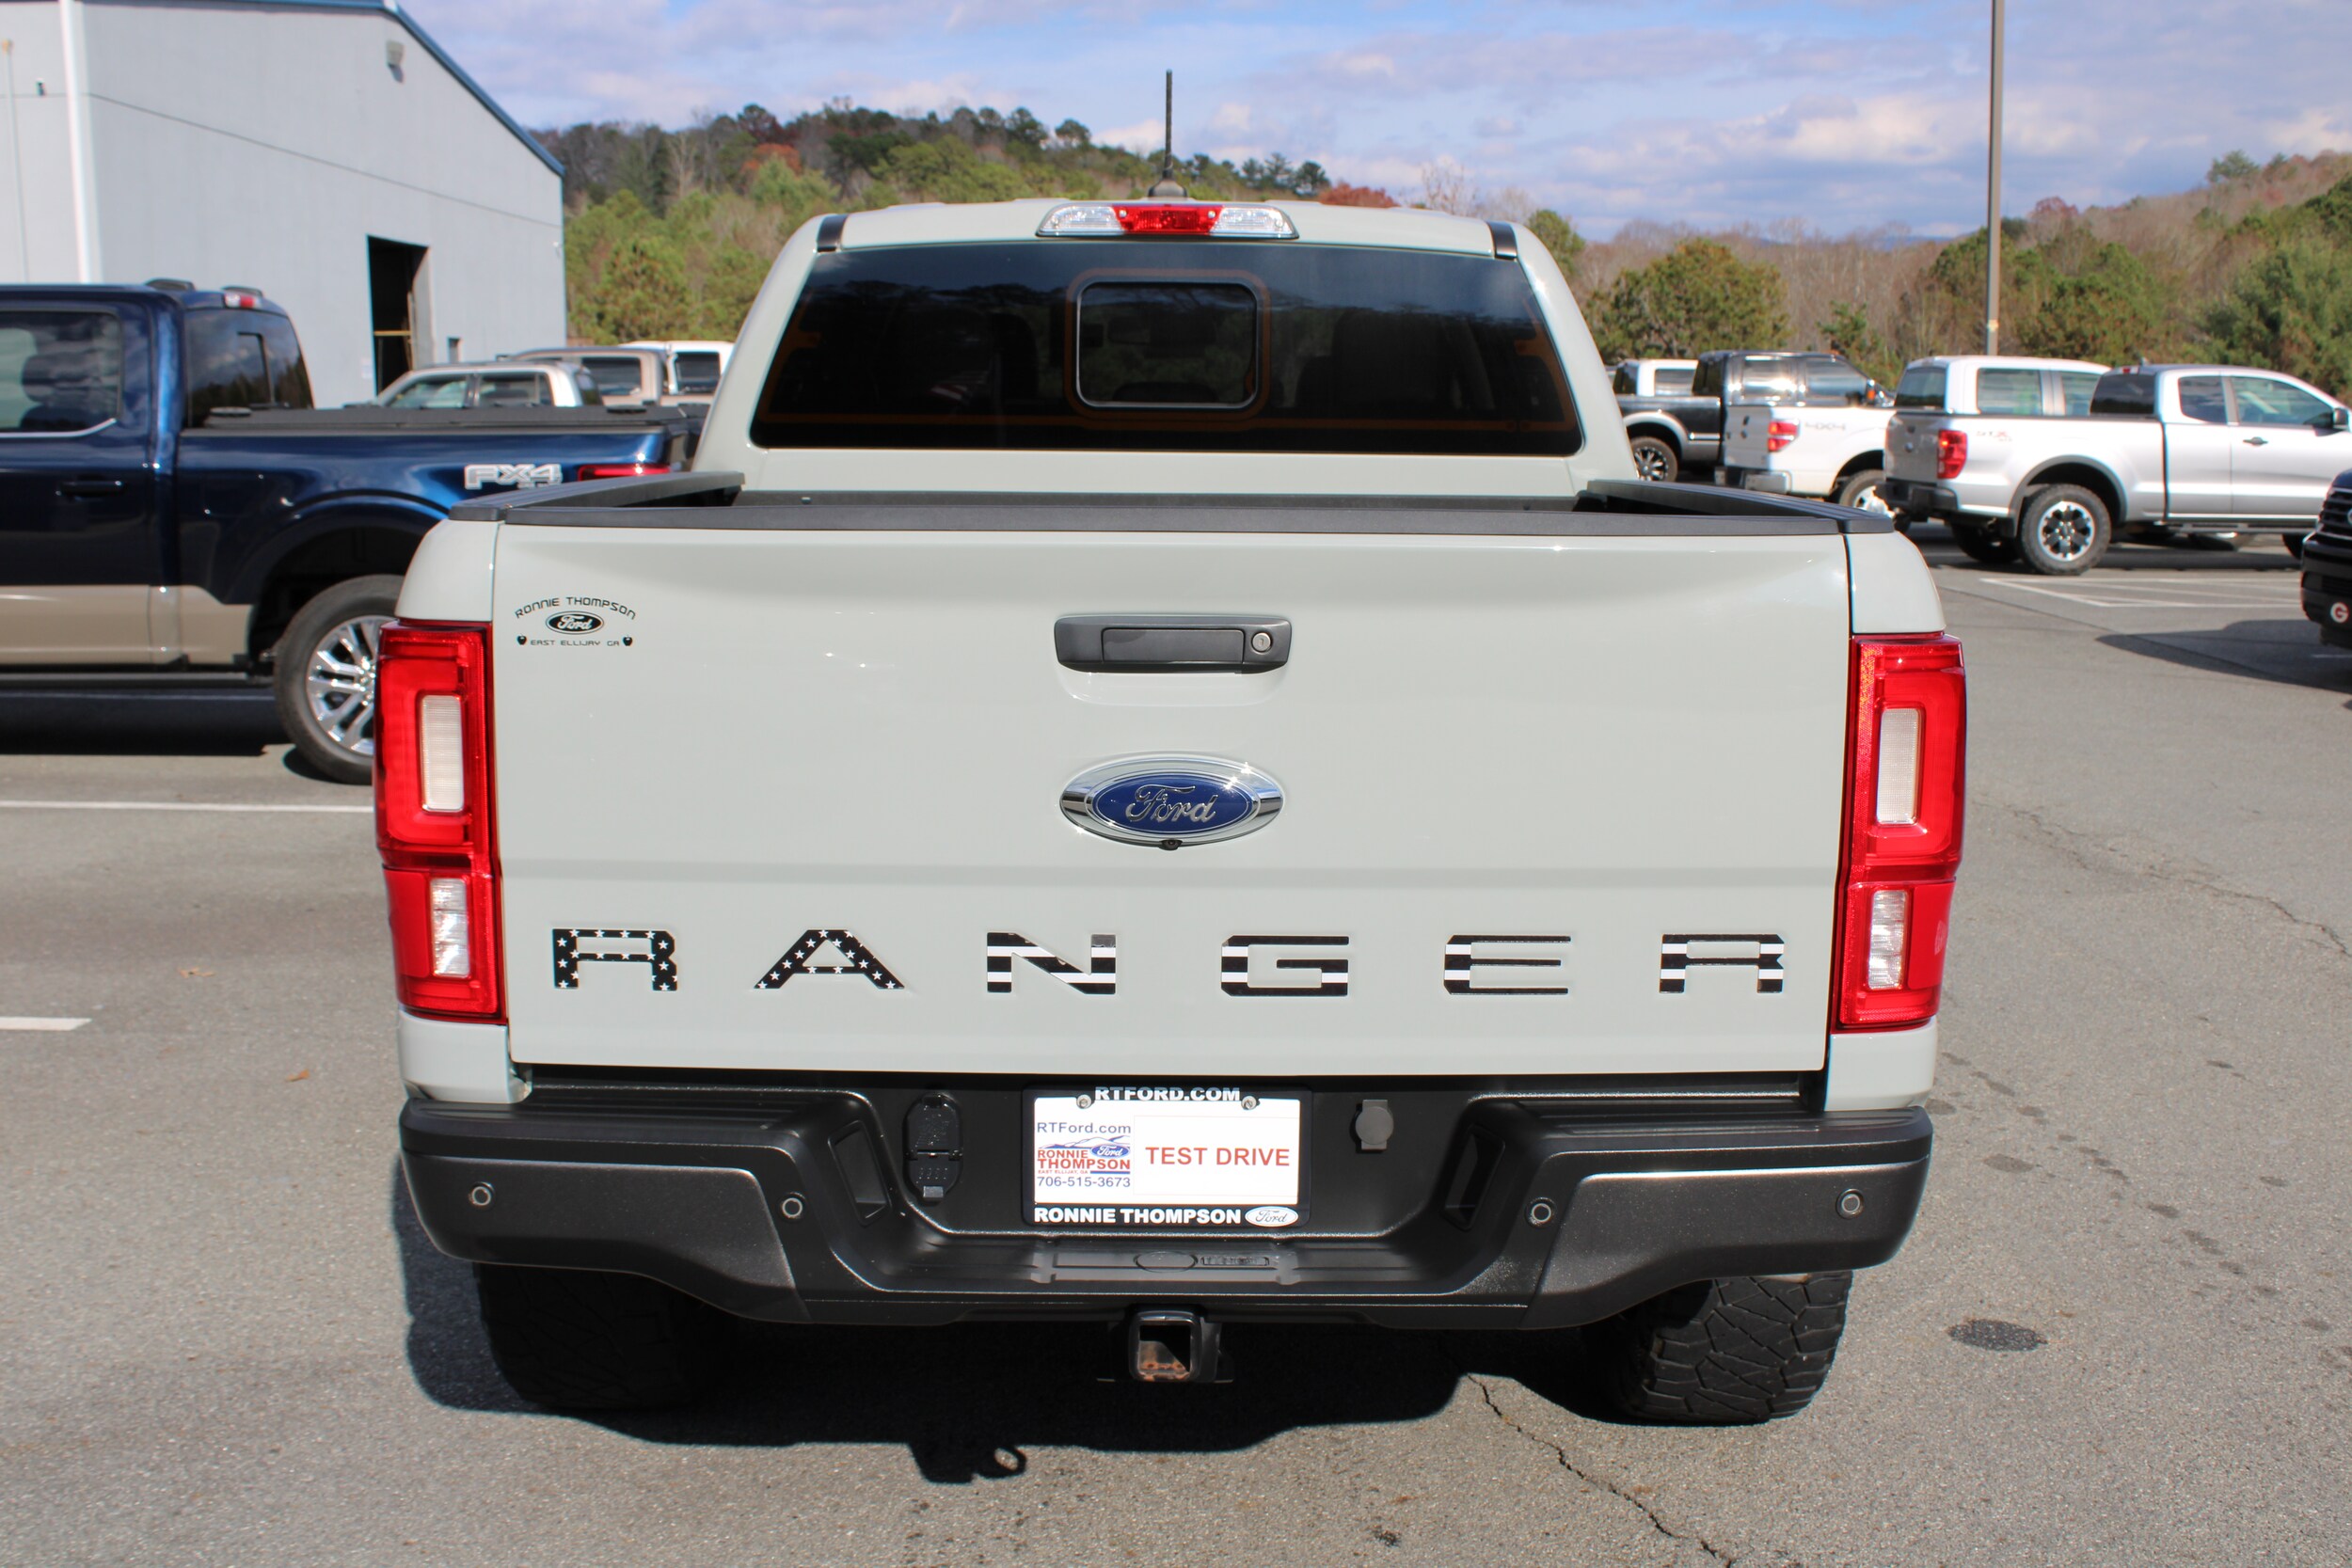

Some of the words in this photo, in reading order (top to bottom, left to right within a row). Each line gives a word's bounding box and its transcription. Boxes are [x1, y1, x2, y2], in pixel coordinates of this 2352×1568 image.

[465, 464, 563, 490] FX4
[515, 597, 561, 619] RONNIE
[565, 596, 637, 620] THOMPSON
[557, 613, 593, 630] Ford
[1125, 784, 1219, 824] Ford
[552, 927, 1785, 997] RANGER
[1094, 1085, 1240, 1101] RTFORD.COM
[1037, 1121, 1131, 1134] RTFord.com
[1038, 1149, 1089, 1159] RONNIE
[1096, 1145, 1123, 1156] Ford
[1145, 1147, 1208, 1165] TEST
[1216, 1148, 1291, 1166] DRIVE
[1037, 1158, 1131, 1170] THOMPSON
[1037, 1176, 1131, 1188] 706-515-3673
[1034, 1208, 1116, 1223] RONNIE
[1120, 1209, 1242, 1224] THOMPSON
[1255, 1209, 1289, 1224] Ford
